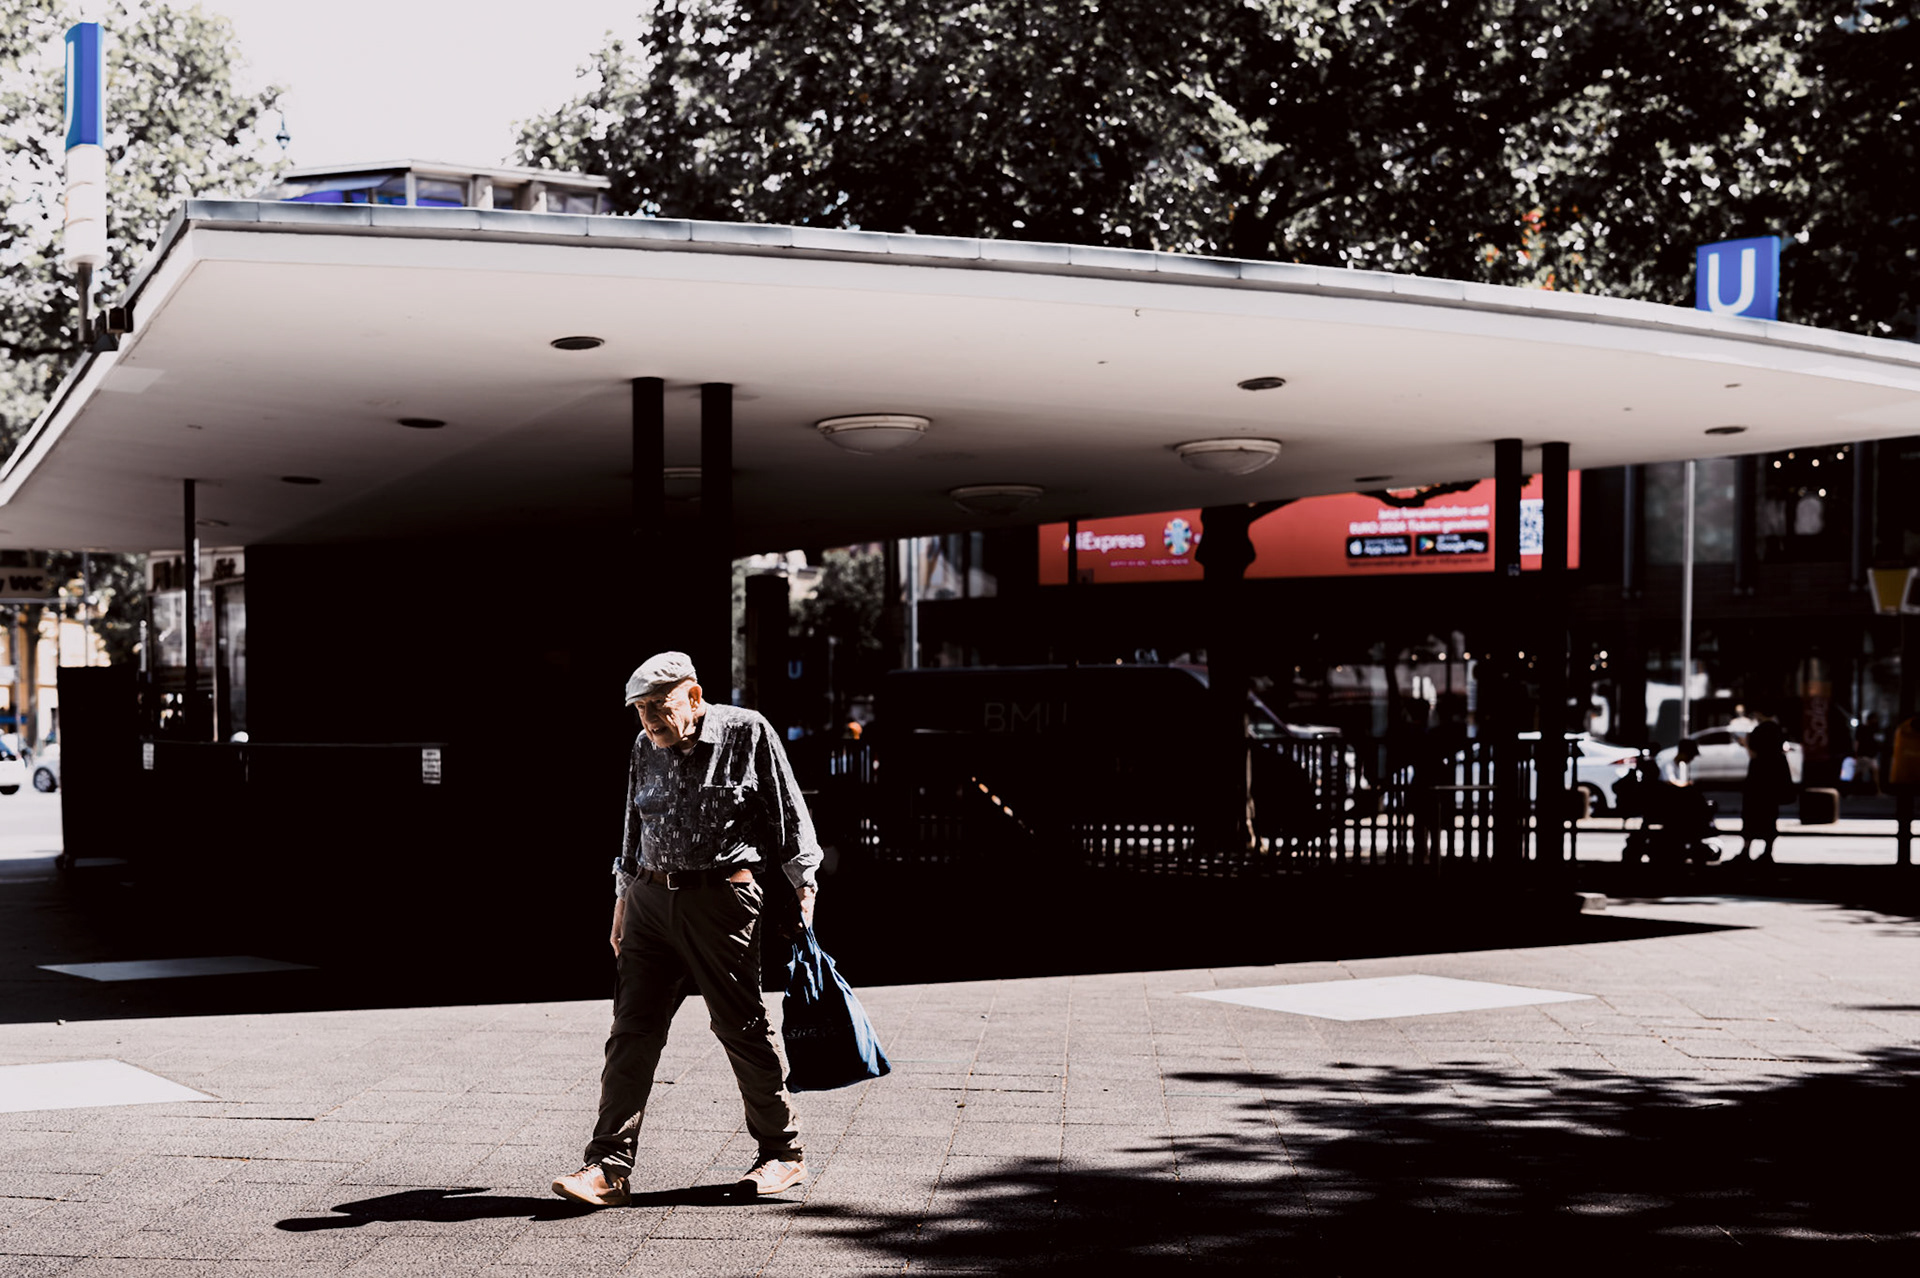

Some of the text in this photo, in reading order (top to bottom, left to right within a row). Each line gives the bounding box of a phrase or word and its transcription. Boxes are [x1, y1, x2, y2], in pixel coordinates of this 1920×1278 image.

[1707, 248, 1756, 316] U
[9, 575, 43, 592] WC
[787, 658, 803, 680] U
